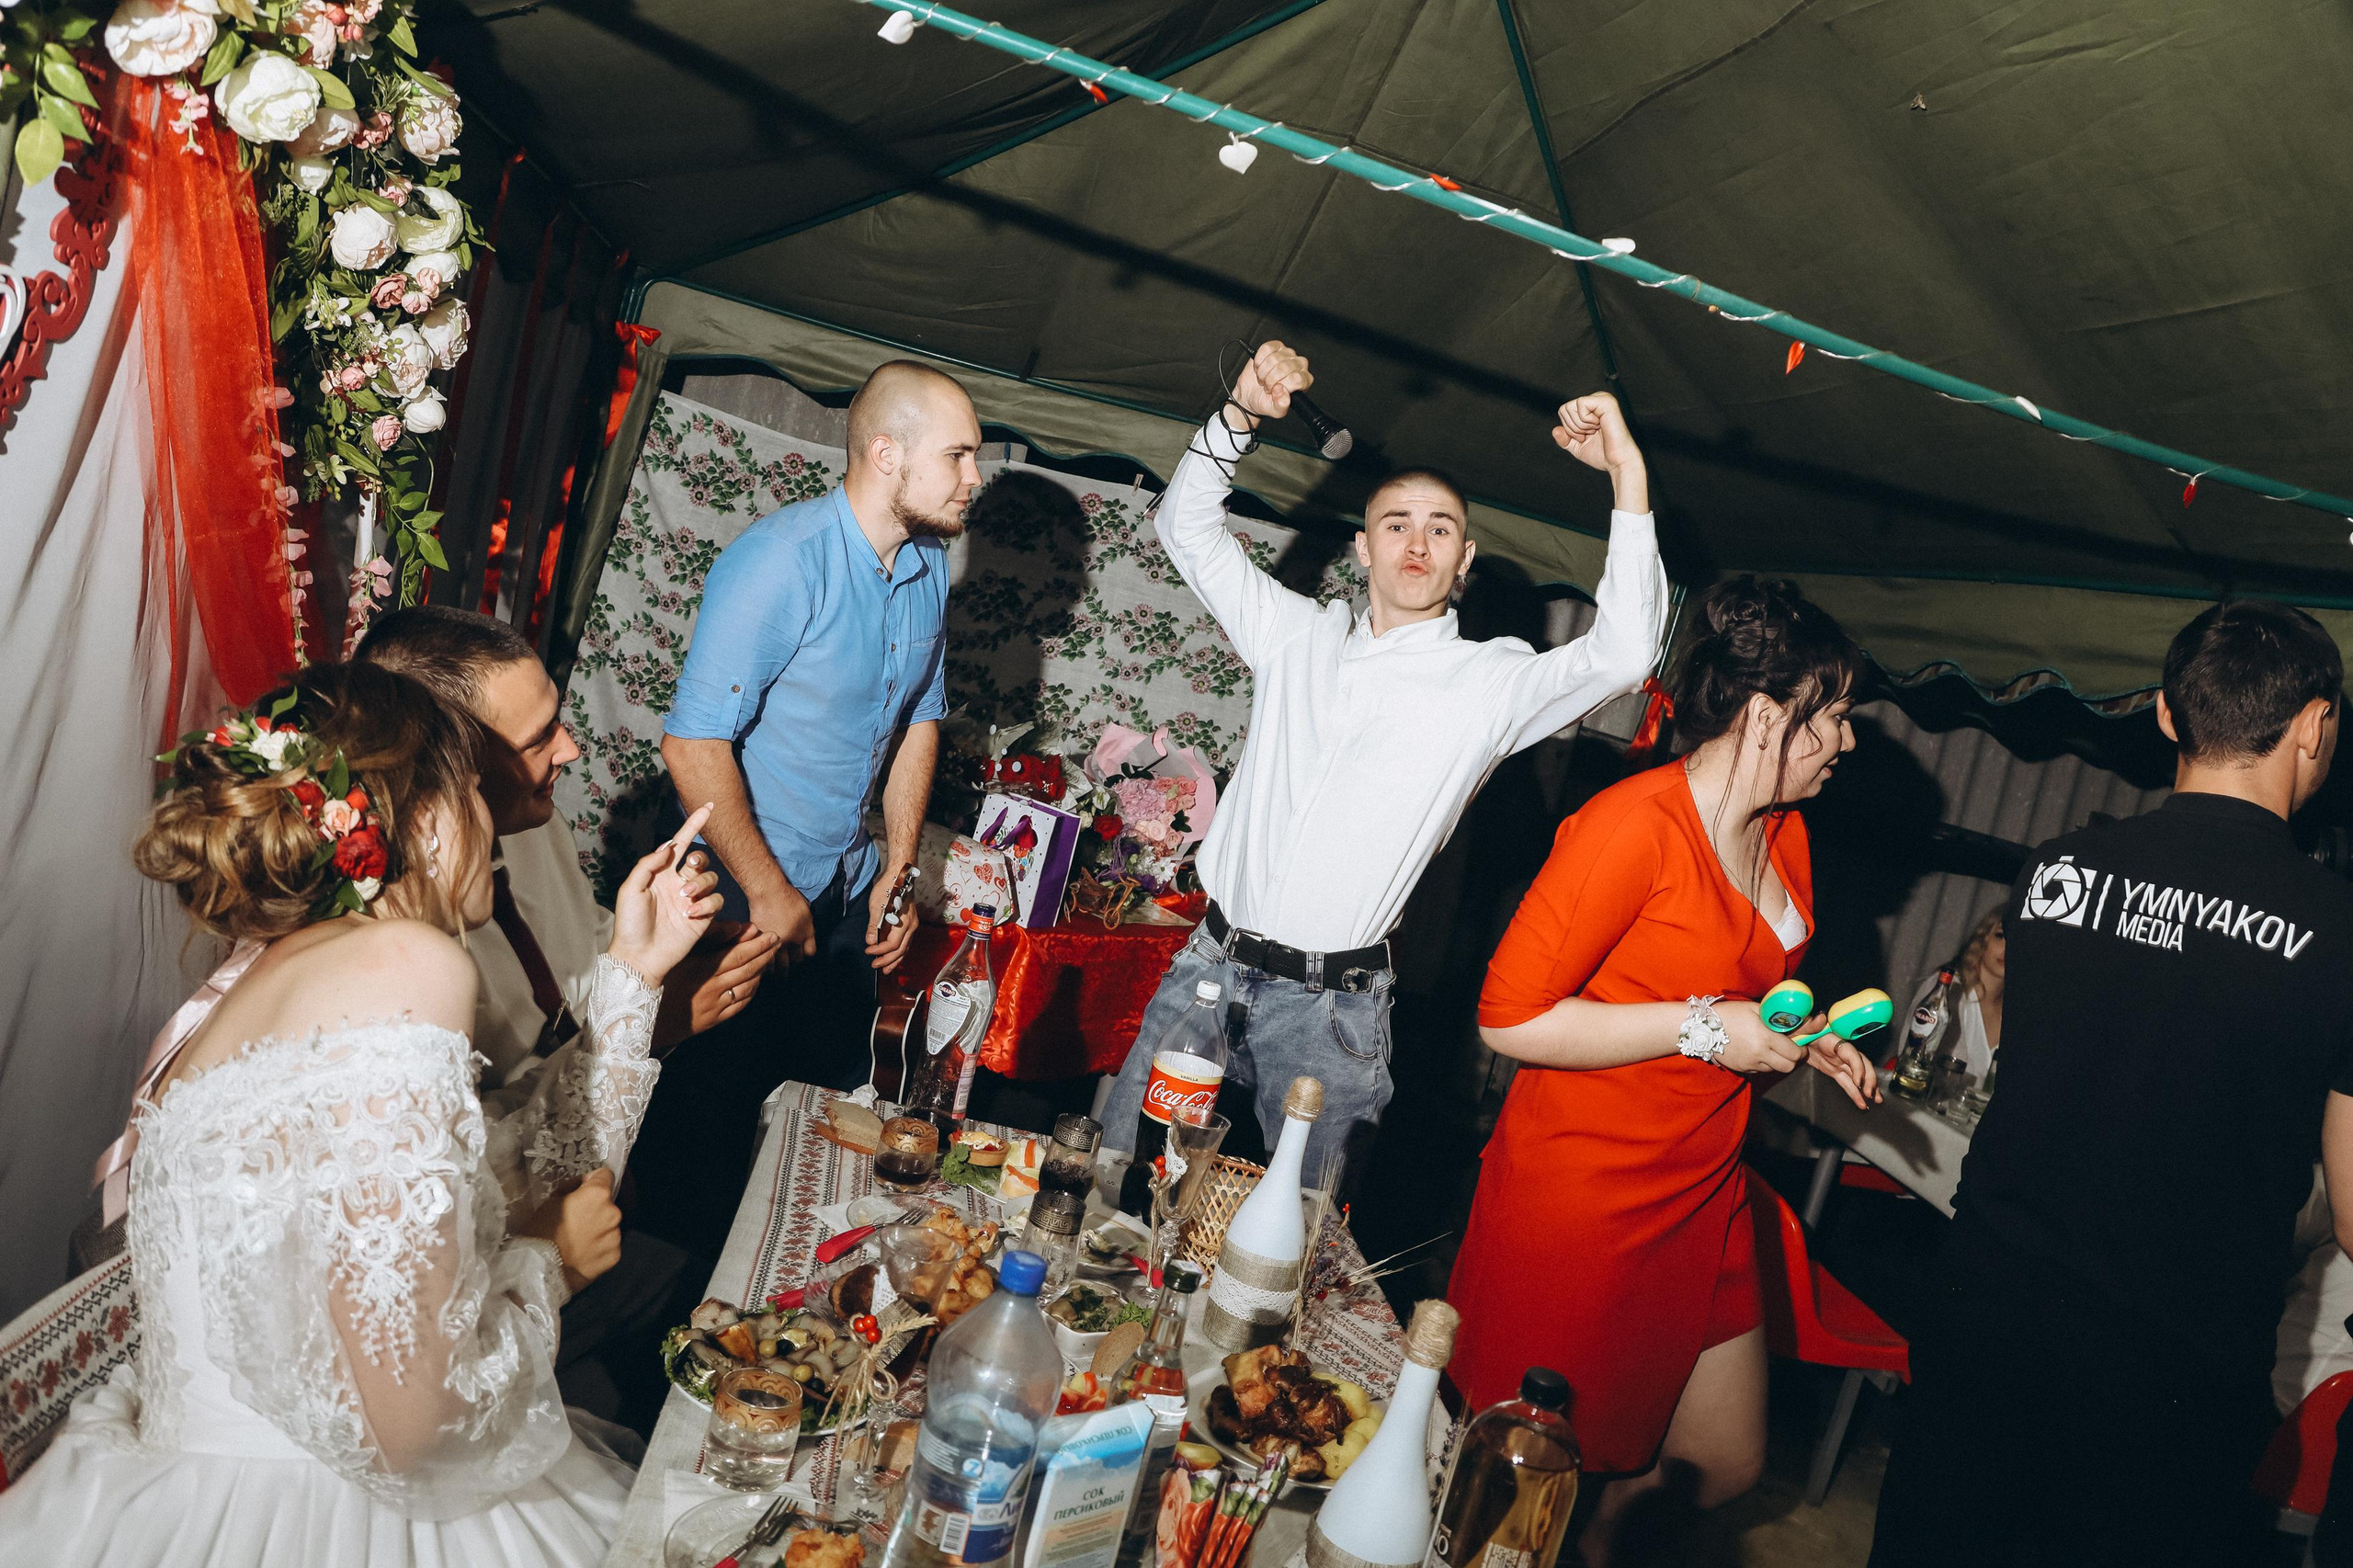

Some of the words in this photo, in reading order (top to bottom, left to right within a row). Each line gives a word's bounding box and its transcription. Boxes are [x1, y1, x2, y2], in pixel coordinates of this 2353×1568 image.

[2121, 878, 2314, 960] YMNYAKOV
[2115, 911, 2185, 953] MEDIA
[1180, 1074, 1199, 1083] VANILLA
[1115, 1425, 1132, 1437] СОК
[1053, 1490, 1125, 1521] ПЕРСИКОВЫЙ
[1082, 1485, 1106, 1502] СОК
